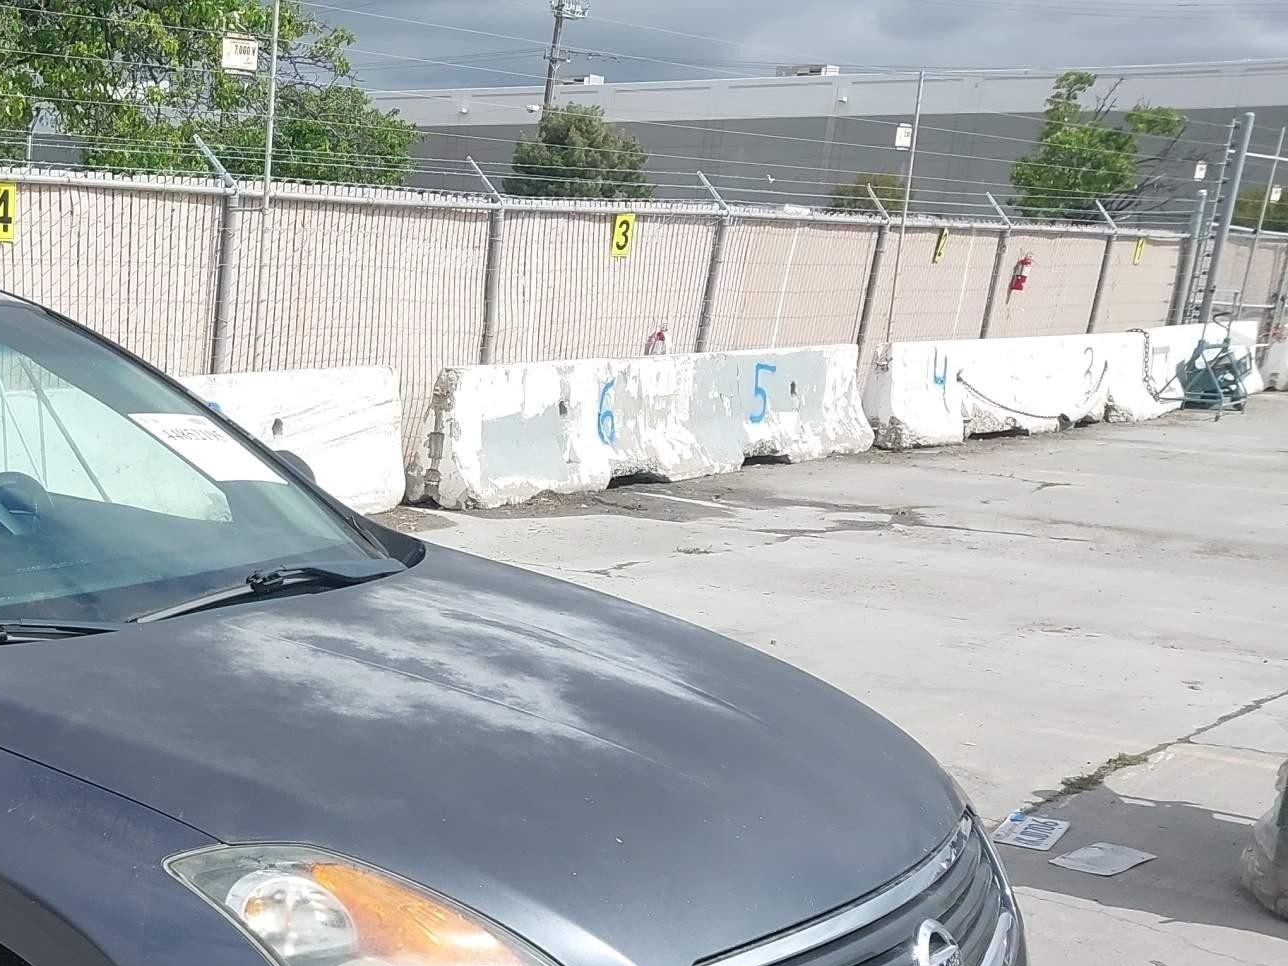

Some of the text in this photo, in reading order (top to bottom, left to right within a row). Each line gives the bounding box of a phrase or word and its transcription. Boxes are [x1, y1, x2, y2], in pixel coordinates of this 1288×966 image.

[615, 219, 630, 251] 3
[597, 377, 616, 445] 6
[749, 362, 777, 424] 5
[932, 346, 951, 413] 4
